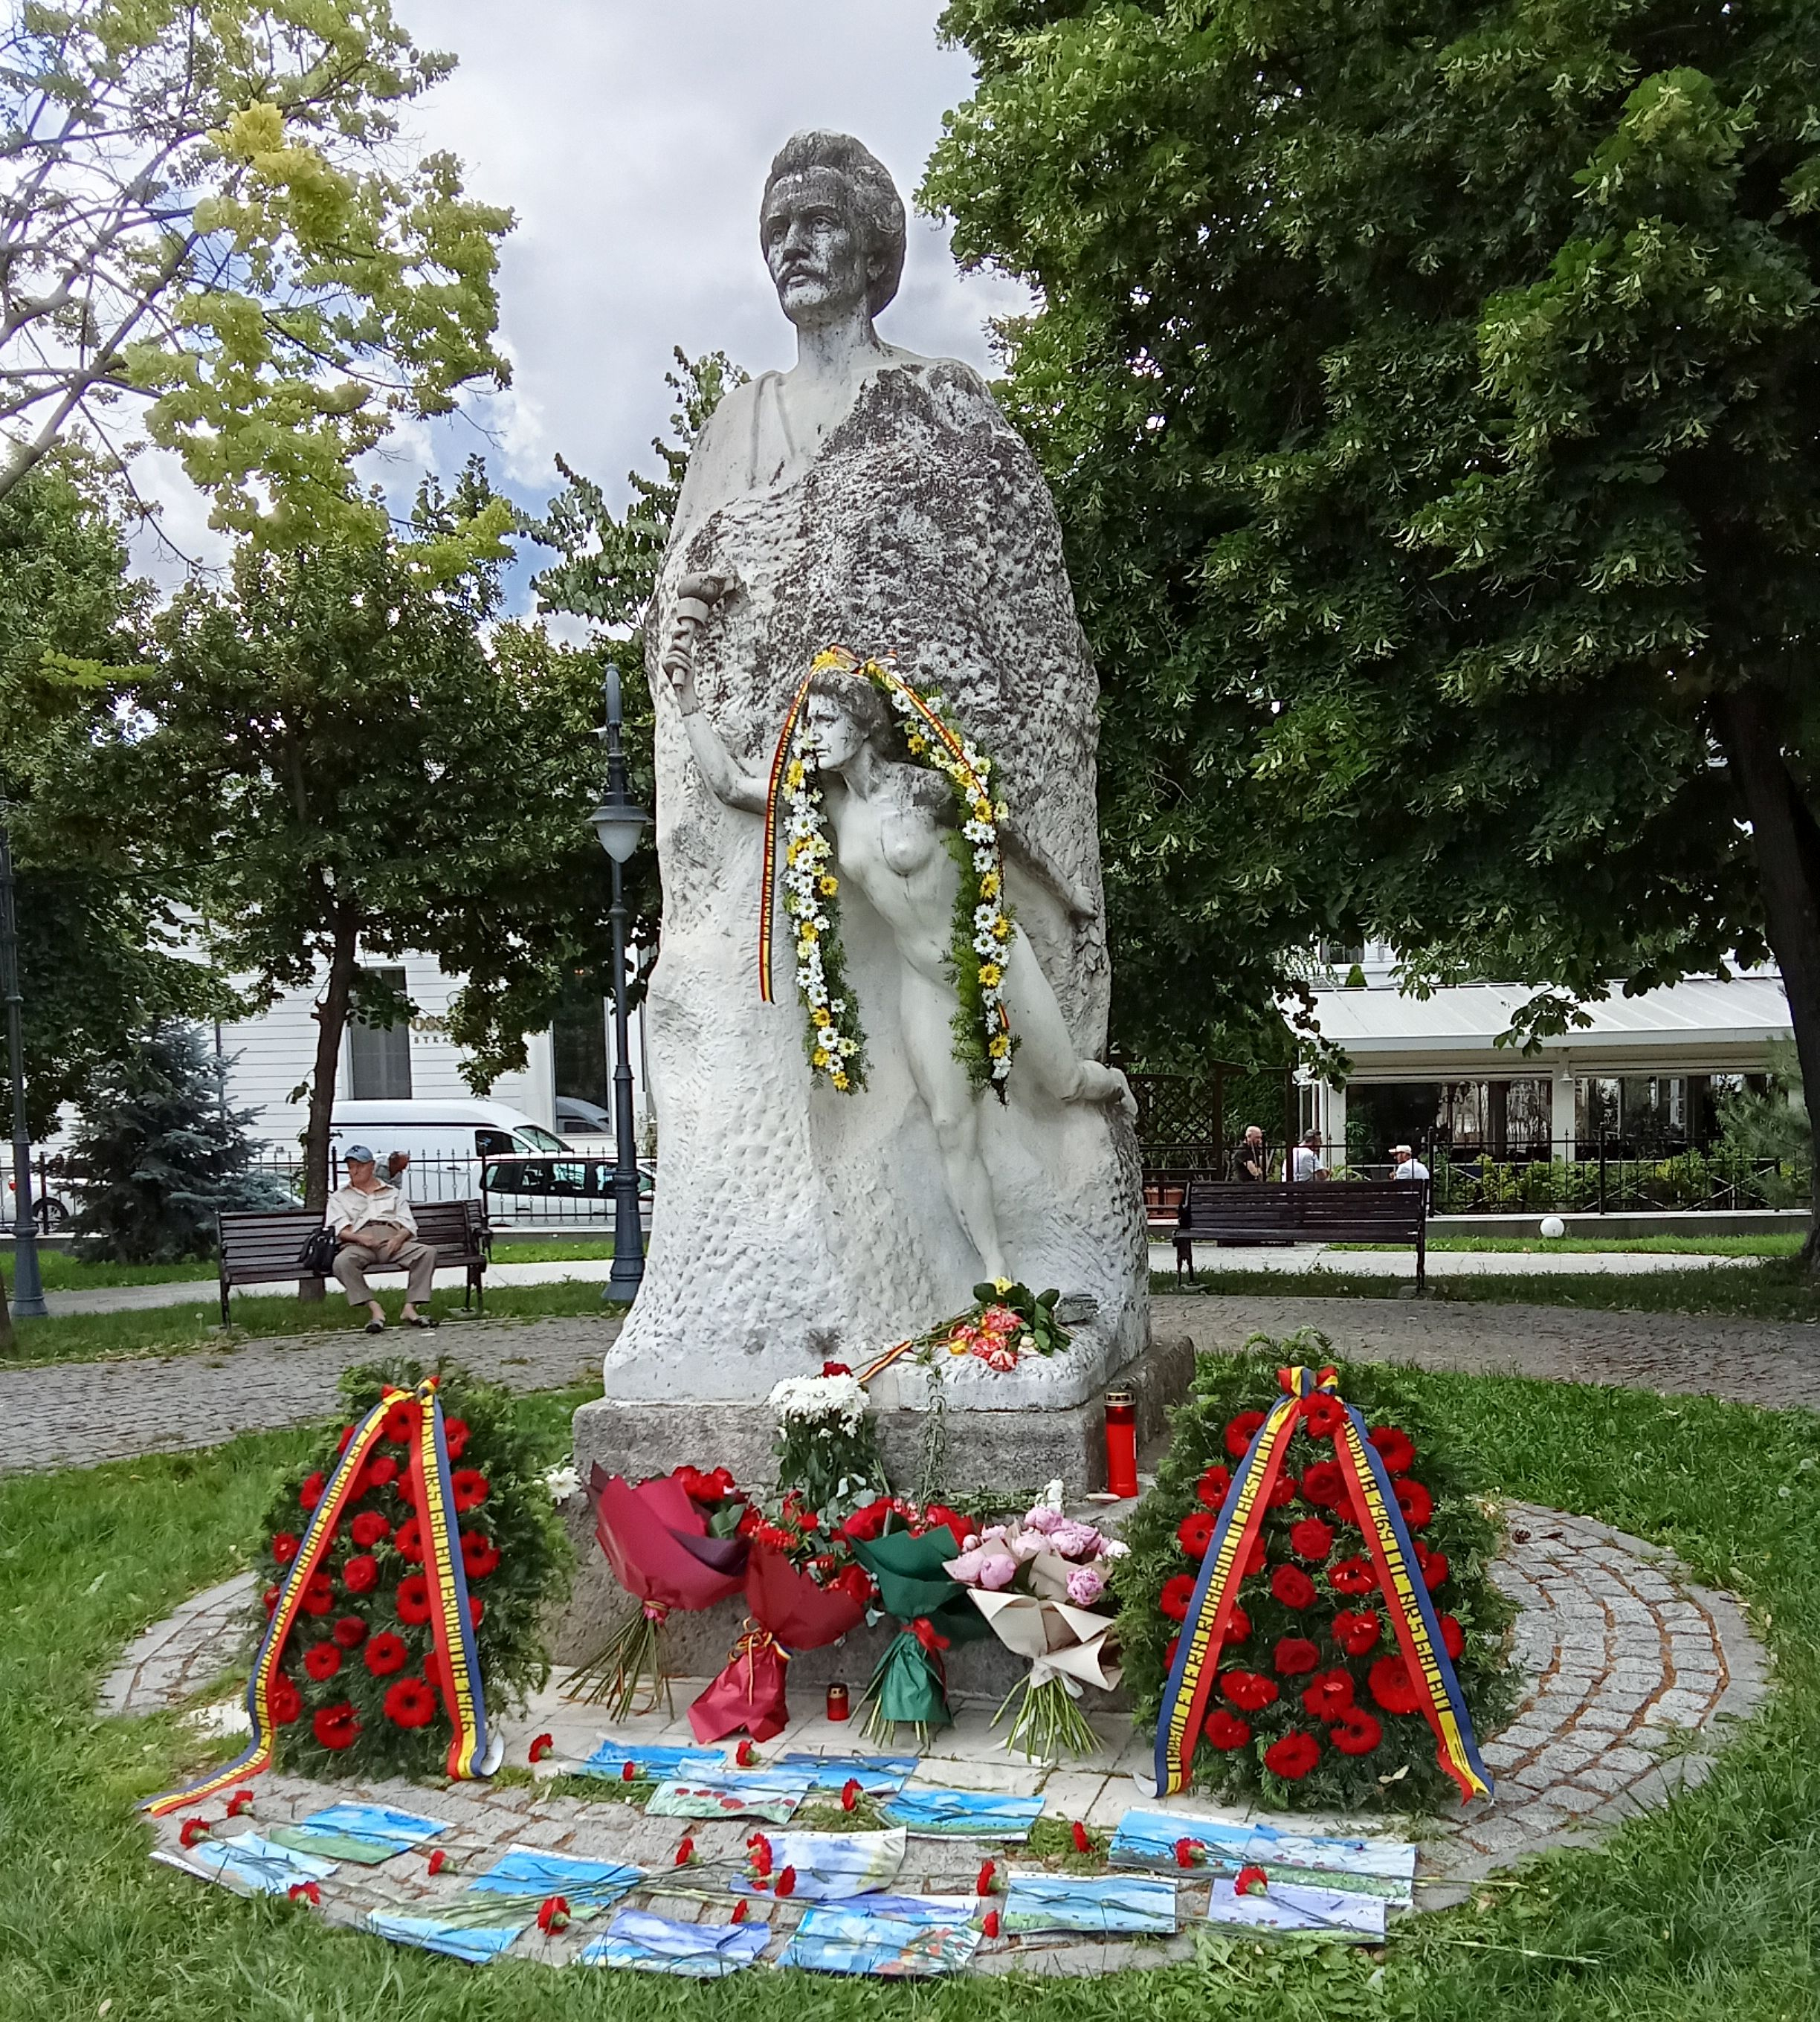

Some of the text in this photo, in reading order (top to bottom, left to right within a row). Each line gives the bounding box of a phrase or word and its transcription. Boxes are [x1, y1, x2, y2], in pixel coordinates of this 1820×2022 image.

[1366, 1496, 1395, 1543] 1969
[1176, 1638, 1208, 1708] ETERN
[455, 1687, 476, 1734] 1966
